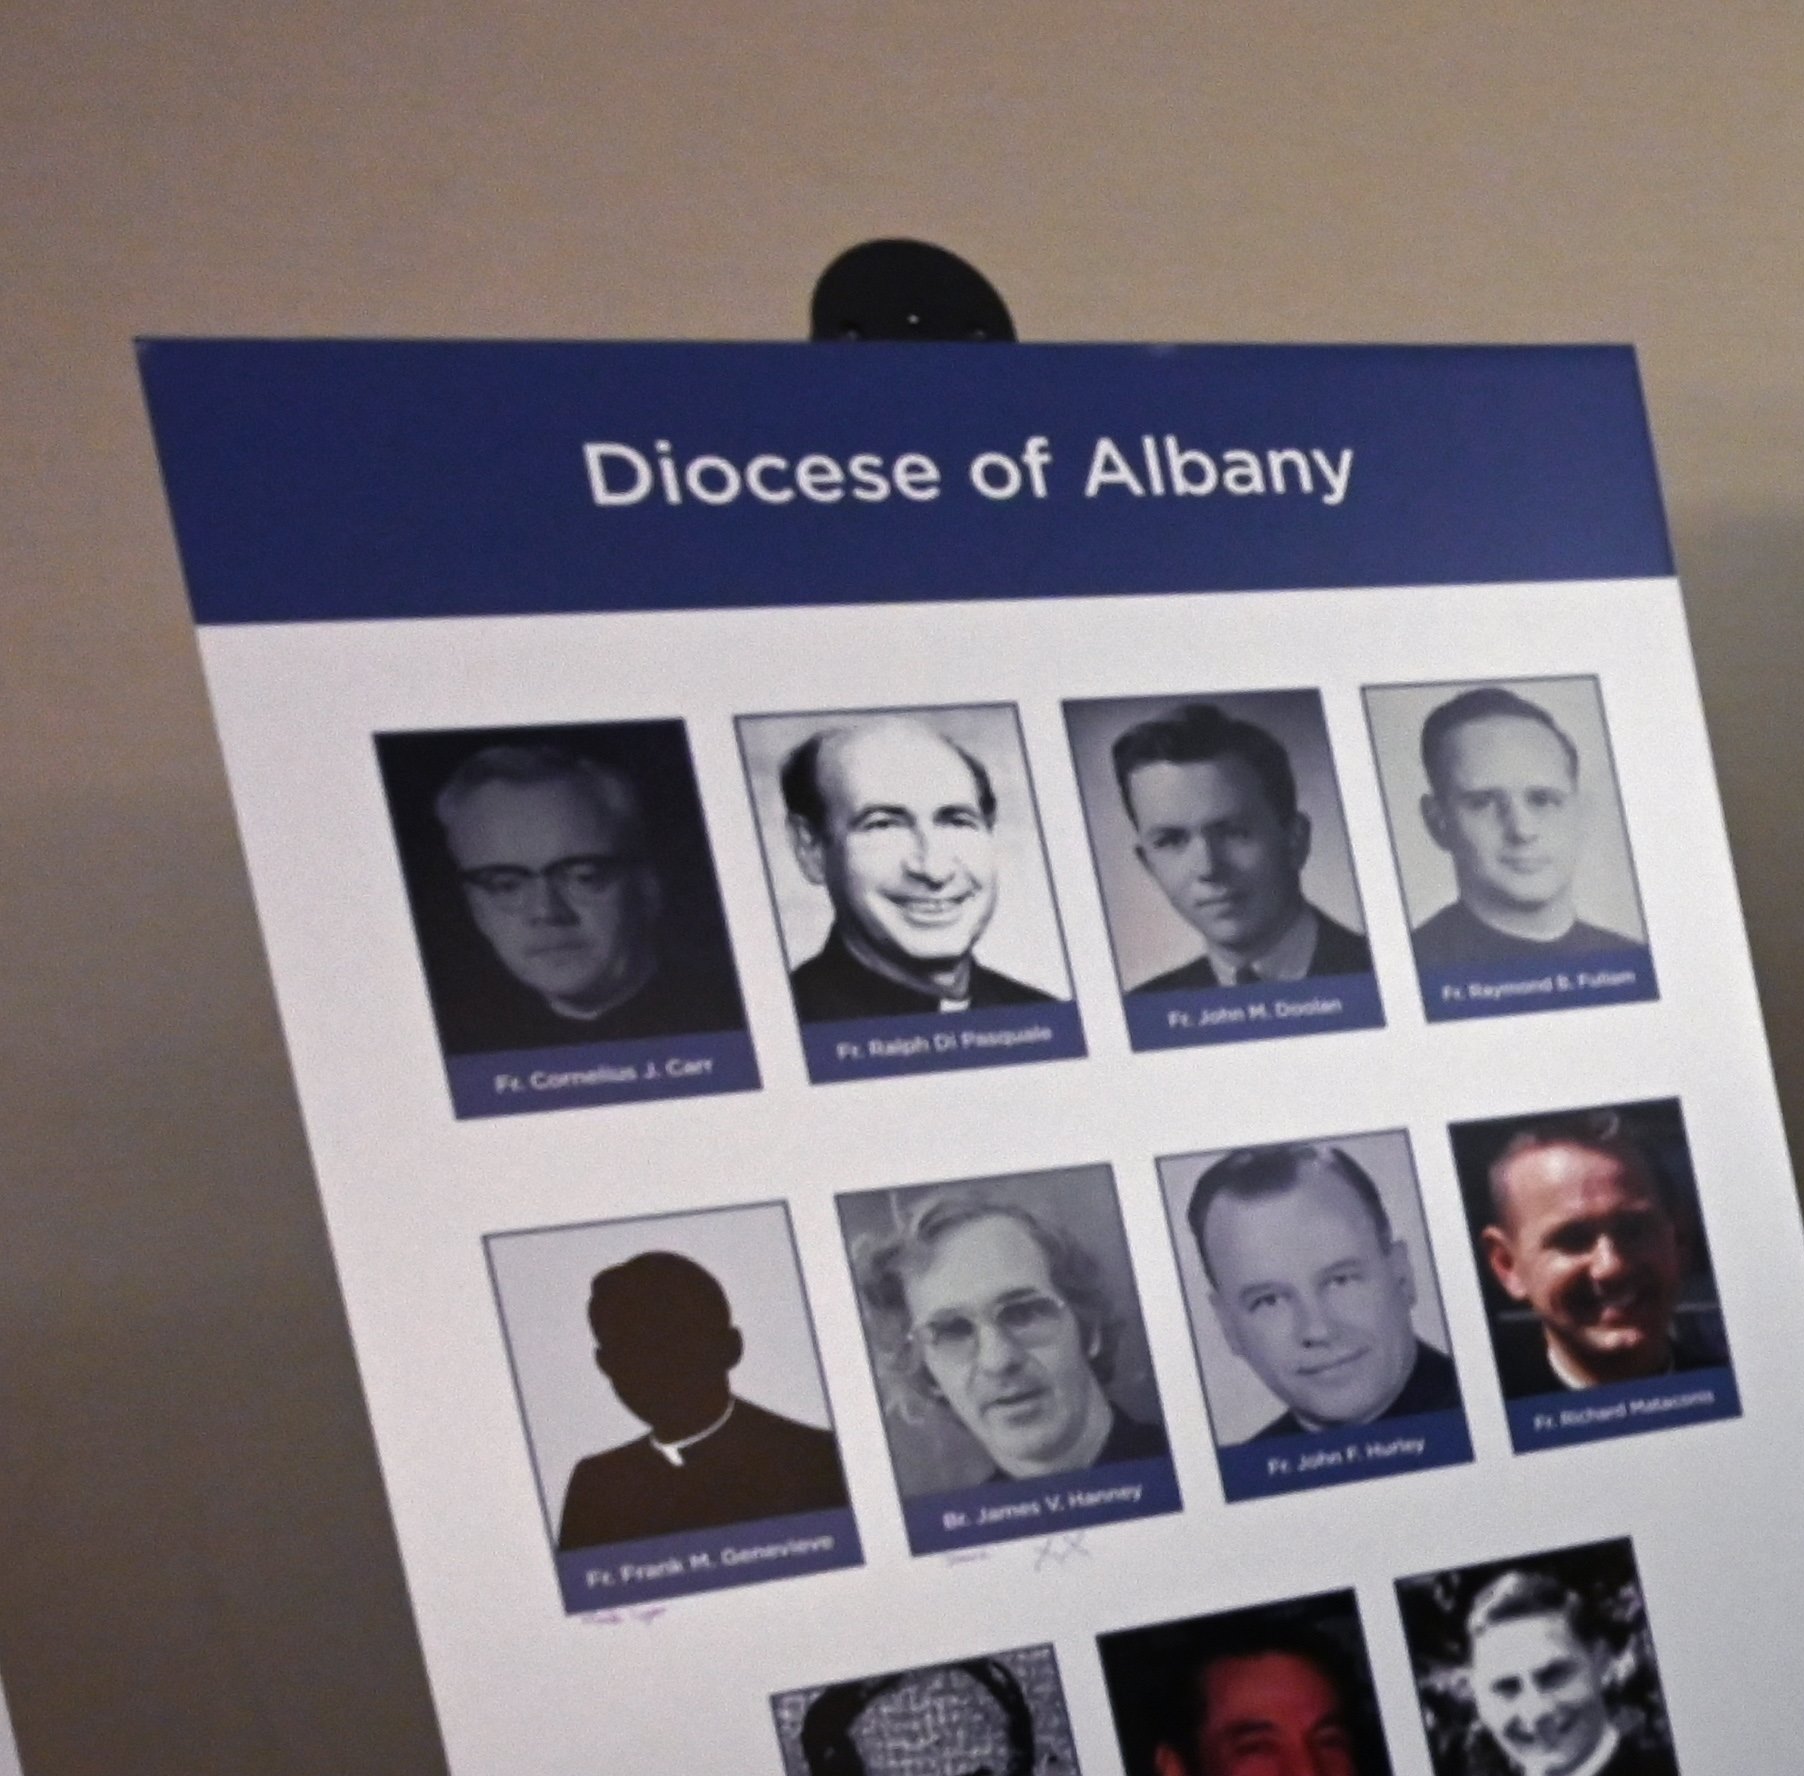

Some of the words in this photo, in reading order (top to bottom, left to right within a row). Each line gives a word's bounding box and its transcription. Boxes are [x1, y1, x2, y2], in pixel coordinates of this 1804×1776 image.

[582, 439, 942, 506] Diocese
[970, 435, 1052, 500] of
[1085, 433, 1355, 506] Albany
[1467, 976, 1554, 1001] Raymond
[1166, 1010, 1193, 1028] Fr.
[1198, 1007, 1246, 1027] John
[1247, 1002, 1271, 1019] M.
[835, 1042, 861, 1060] Fr.
[867, 1035, 930, 1057] Ralph
[493, 1074, 524, 1094] Fr.
[529, 1065, 639, 1091] Cornelius
[642, 1061, 662, 1080] J.
[664, 1058, 713, 1078] Carr
[1533, 1414, 1558, 1431] Fr.
[1559, 1401, 1628, 1427] Richard
[1267, 1457, 1289, 1475] Fr.
[1297, 1450, 1343, 1472] John
[1345, 1445, 1358, 1462] F.
[1365, 1438, 1425, 1459] Hurley
[942, 1511, 967, 1531] Br.
[976, 1501, 1041, 1526] James
[1043, 1493, 1065, 1513] V.
[585, 1569, 615, 1588] Fr.
[619, 1557, 685, 1583] Frank
[688, 1552, 713, 1570] M.
[720, 1535, 835, 1567] Genevieve
